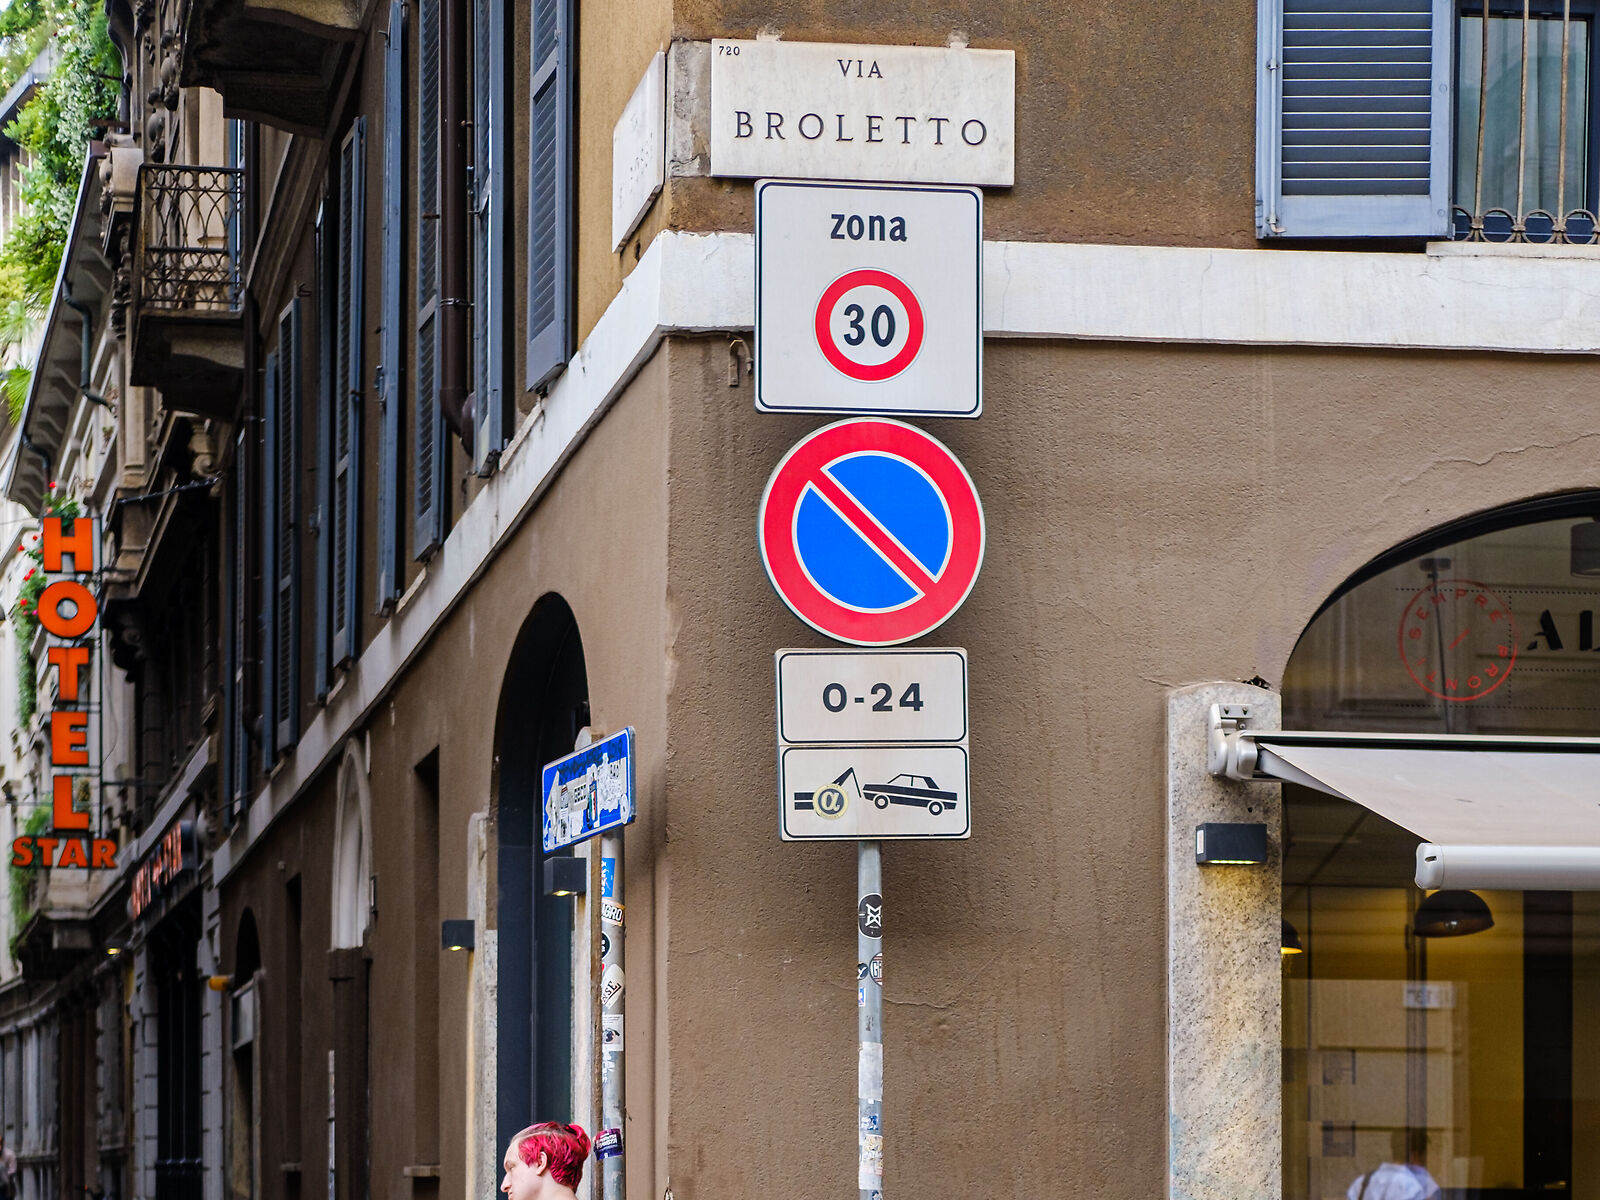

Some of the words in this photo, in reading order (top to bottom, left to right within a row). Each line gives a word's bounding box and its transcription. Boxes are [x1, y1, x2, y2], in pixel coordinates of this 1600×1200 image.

[718, 45, 741, 56] 720
[837, 59, 884, 79] VIA
[734, 110, 988, 146] BROLETTO
[829, 213, 908, 243] zona
[843, 303, 897, 348] 30
[37, 516, 98, 831] HOTEL
[822, 682, 924, 713] 0-24
[11, 836, 118, 869] STAR
